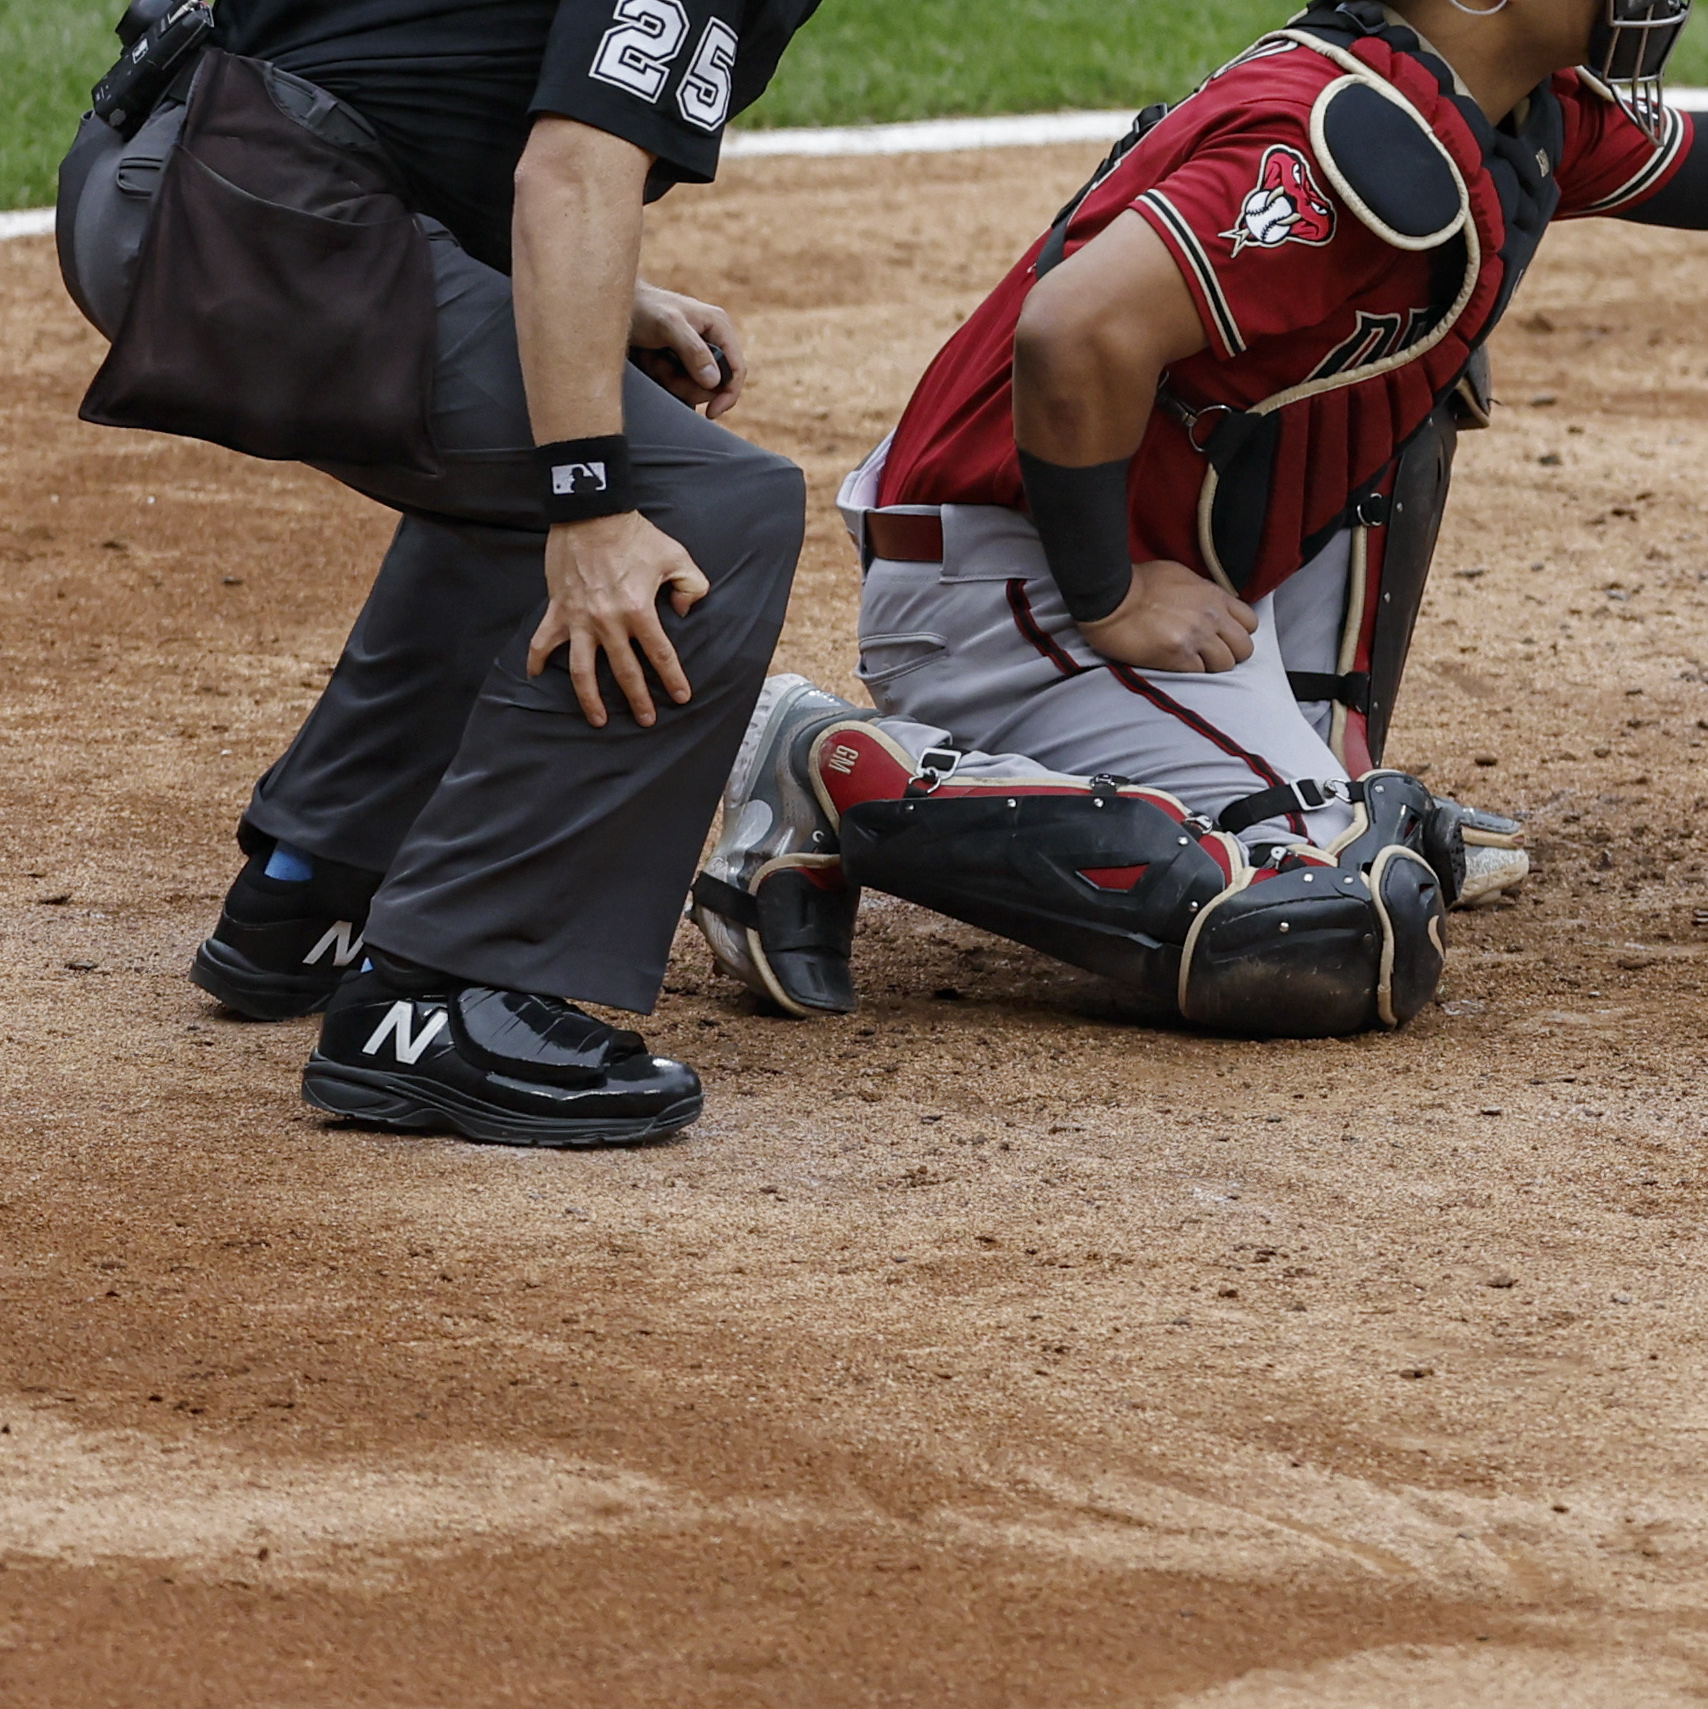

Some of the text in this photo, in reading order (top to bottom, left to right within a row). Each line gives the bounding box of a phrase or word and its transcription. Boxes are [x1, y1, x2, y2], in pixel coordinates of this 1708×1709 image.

[828, 745, 859, 775] GM
[302, 920, 364, 966] N
[362, 1000, 449, 1065] N
